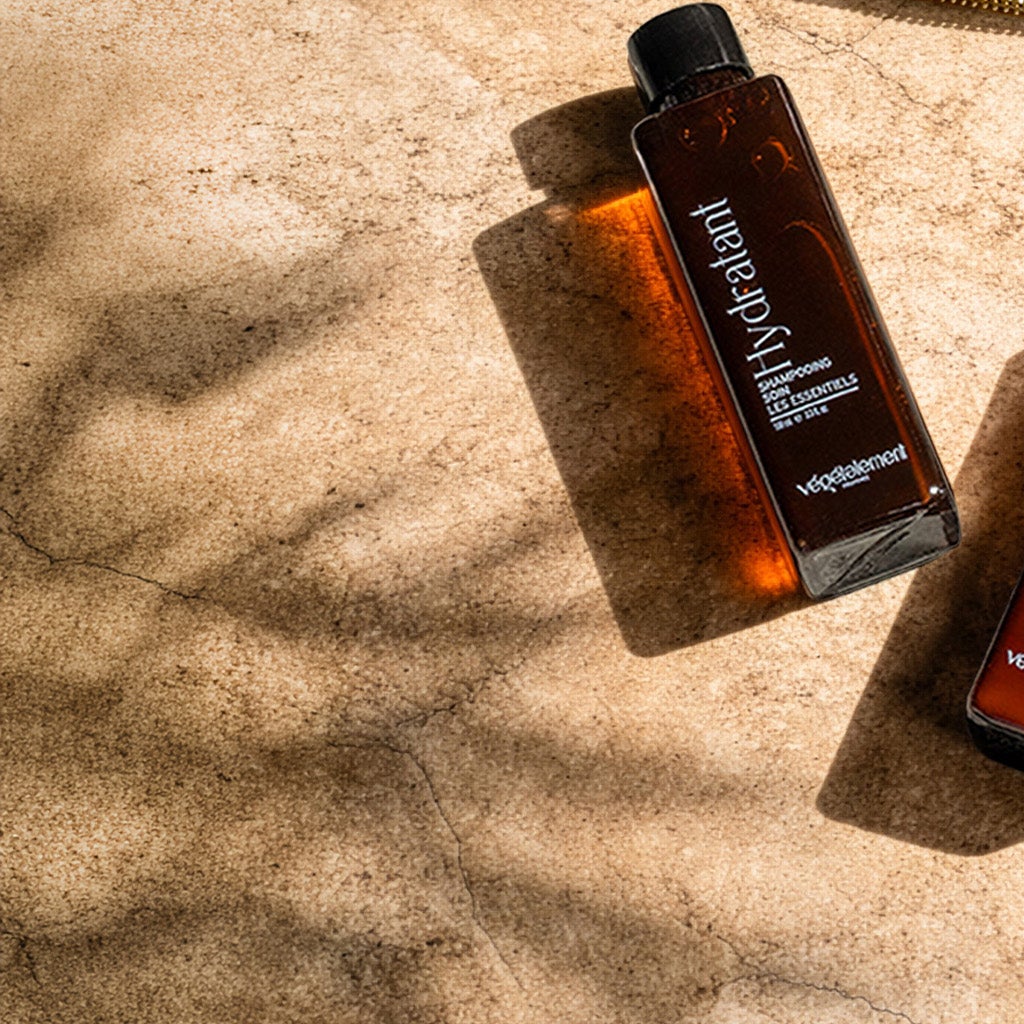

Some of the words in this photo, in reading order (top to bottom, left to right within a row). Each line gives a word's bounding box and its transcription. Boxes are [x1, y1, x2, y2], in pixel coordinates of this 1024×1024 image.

[689, 198, 792, 379] Hydratant
[757, 356, 832, 393] SHAMPOOING
[762, 384, 791, 404] SOIN
[766, 398, 789, 416] LES
[789, 372, 859, 406] ESSENTIELS
